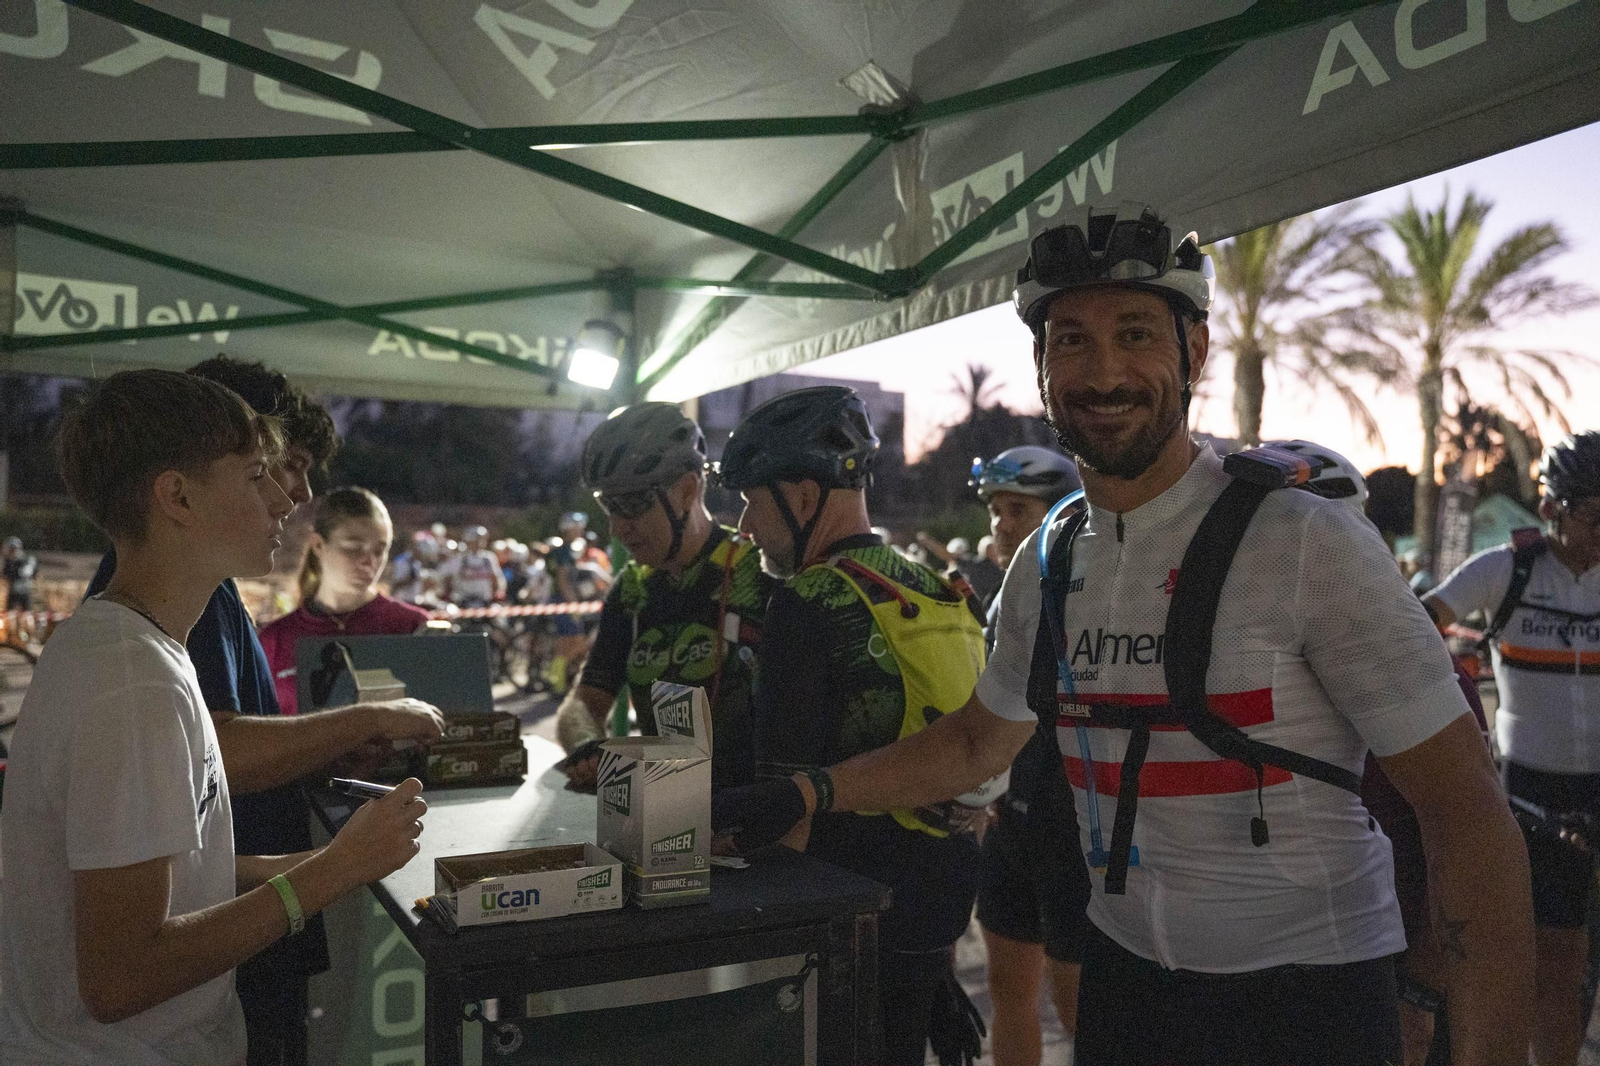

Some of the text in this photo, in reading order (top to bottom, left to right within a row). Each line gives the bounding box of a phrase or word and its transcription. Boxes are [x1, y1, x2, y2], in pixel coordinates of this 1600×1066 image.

[1071, 628, 1166, 666] Almer
[652, 833, 692, 853] FINISHER
[481, 883, 504, 893] BARRITA
[578, 871, 610, 888] FINISHER
[652, 878, 687, 890] ENDURANCE
[481, 888, 540, 911] ucan
